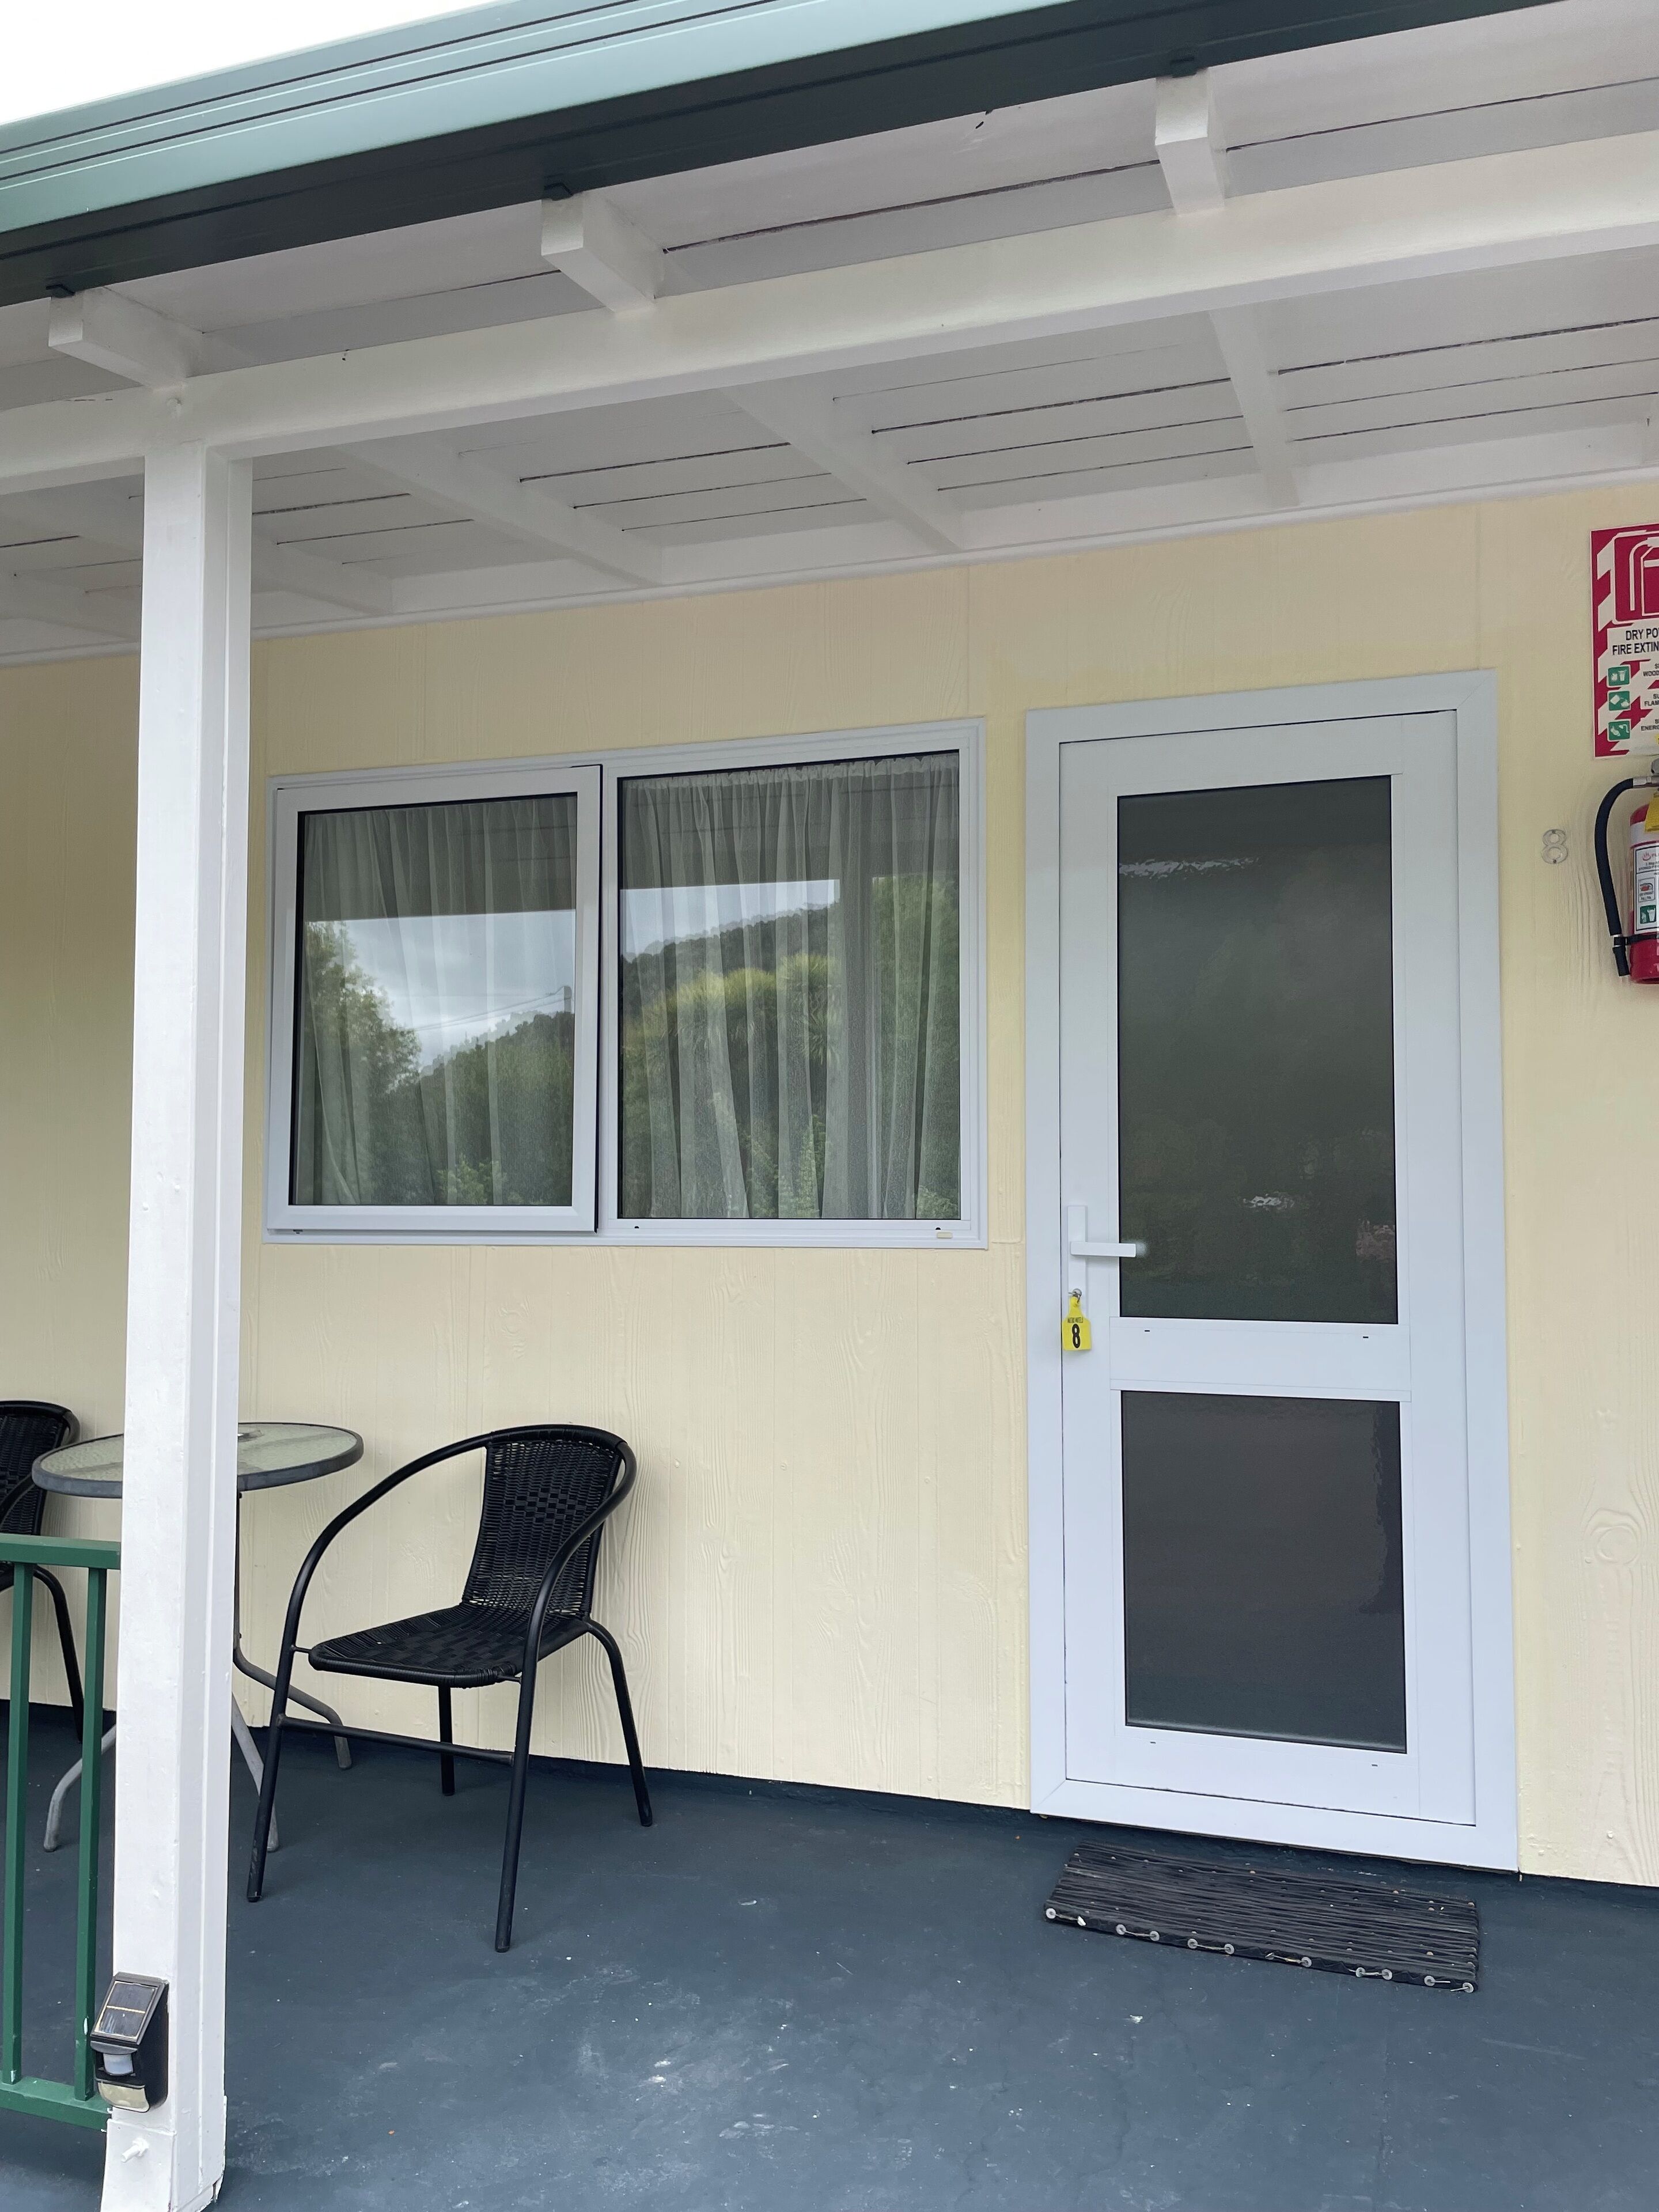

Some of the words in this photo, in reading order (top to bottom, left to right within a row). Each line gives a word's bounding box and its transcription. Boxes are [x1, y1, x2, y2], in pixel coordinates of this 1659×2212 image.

[1626, 629, 1643, 641] DRY
[1646, 627, 1659, 639] PO
[1612, 644, 1632, 655] FIRE
[1541, 829, 1568, 865] 8
[1072, 1324, 1080, 1348] 8
